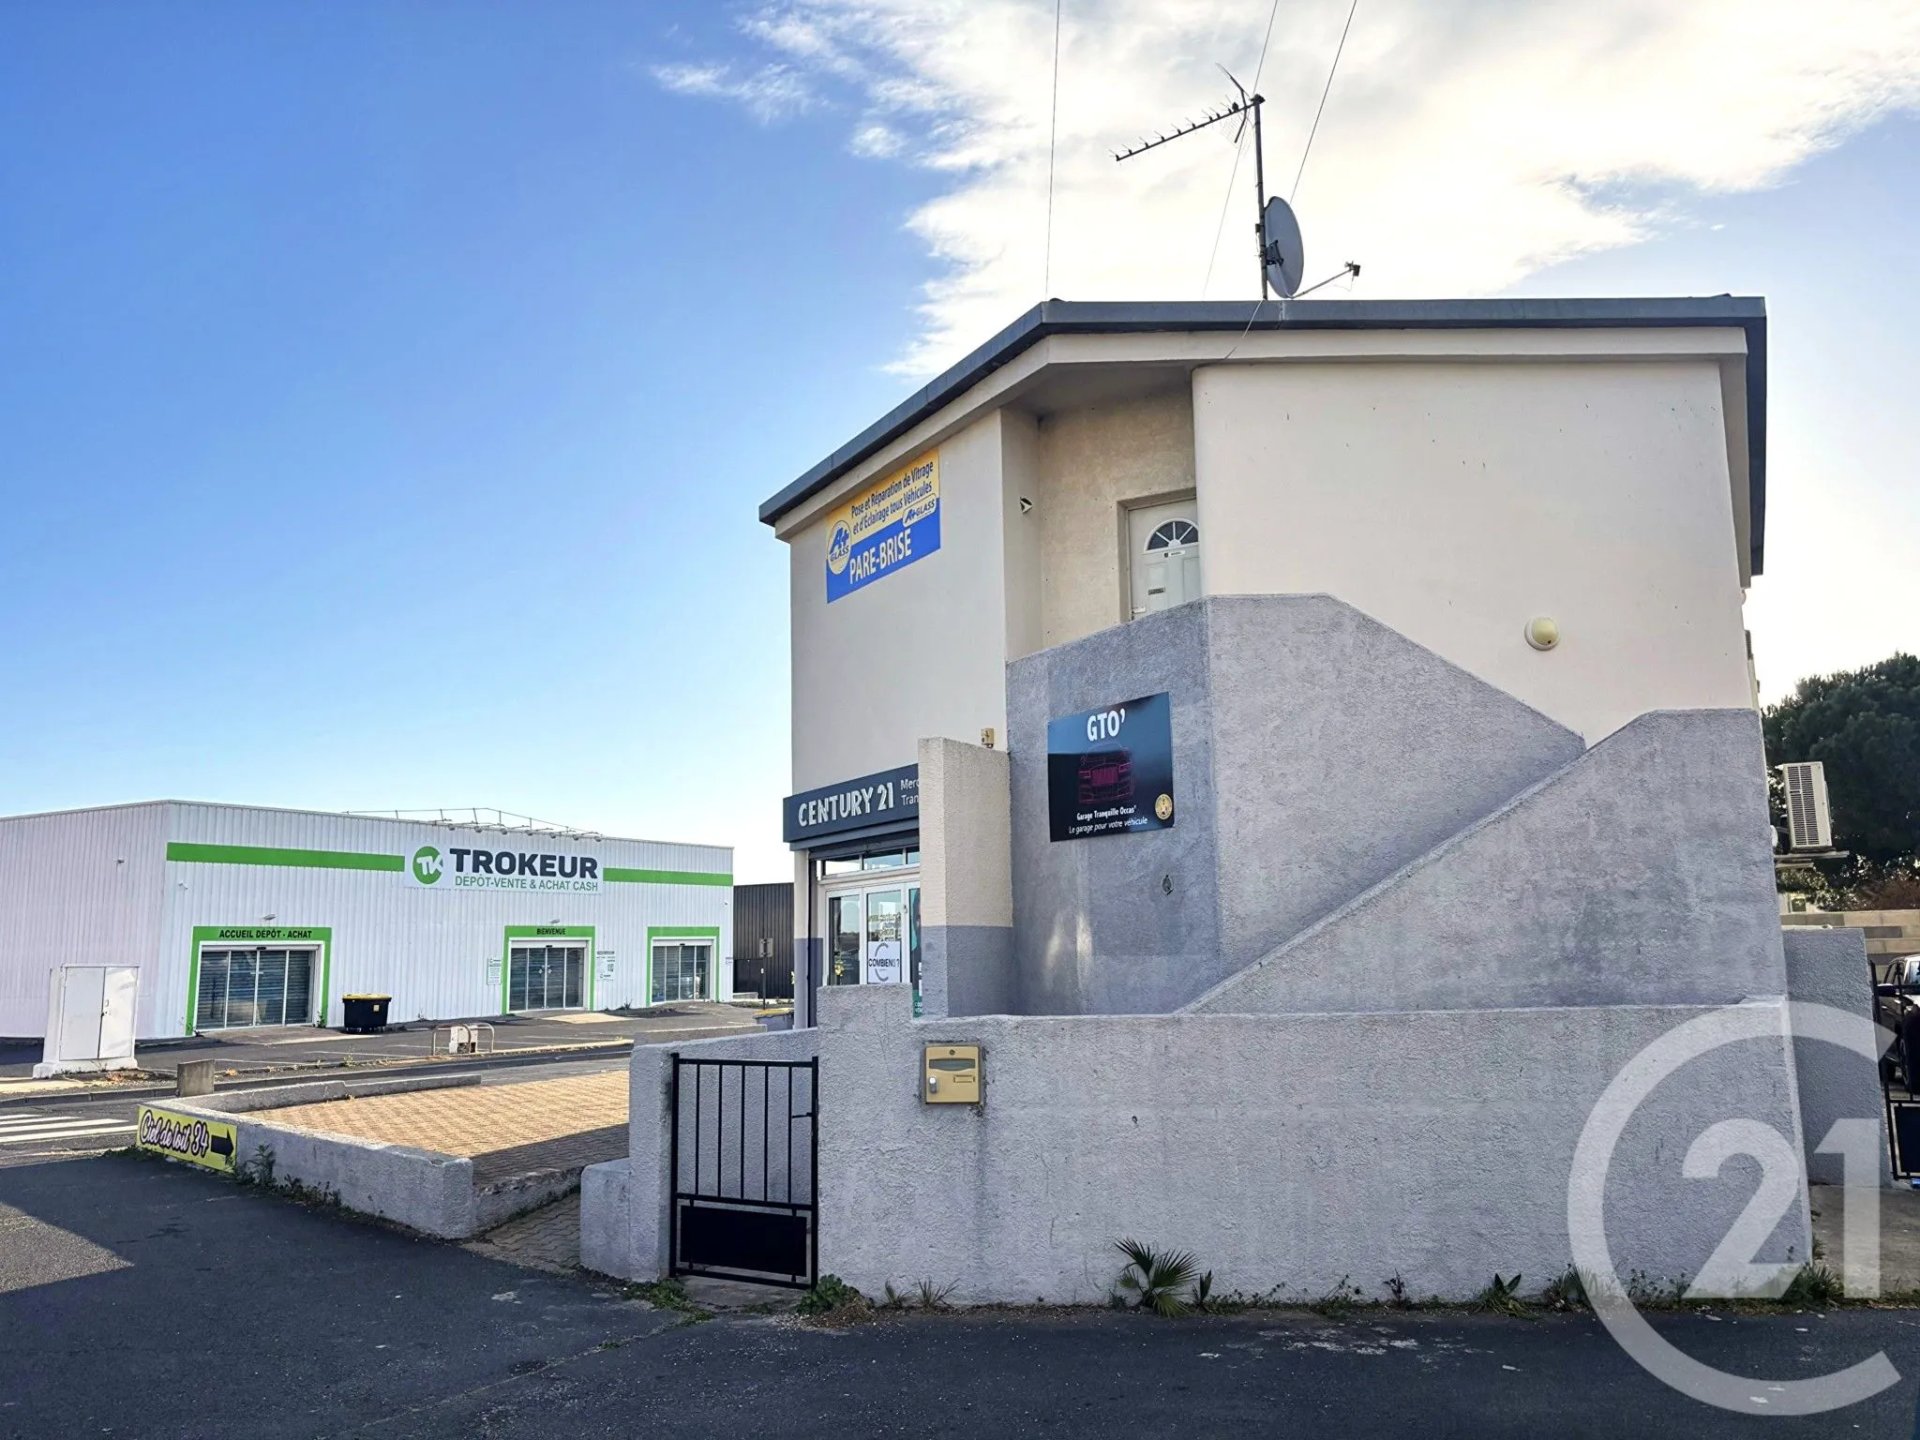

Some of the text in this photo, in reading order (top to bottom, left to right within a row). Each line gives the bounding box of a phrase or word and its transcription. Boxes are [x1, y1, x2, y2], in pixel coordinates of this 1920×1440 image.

[851, 461, 934, 518] Pose et Réparation de Vitrage
[853, 522, 859, 535] et
[890, 498, 903, 514] tous
[903, 481, 933, 506] Véhicules
[830, 545, 850, 562] GLASS
[850, 528, 912, 585] PARE-BRISE
[798, 782, 894, 827] CENTURY 21
[1076, 812, 1093, 822] Garage
[1094, 807, 1119, 819] Tranquille
[1068, 816, 1148, 835] Le garage pour votre véhicule
[450, 848, 598, 879] TROKEUR
[455, 873, 598, 892] DÉPÔT-VENTE & ACHAT CASH
[219, 929, 253, 939] ACCUEIL
[255, 928, 282, 939] DÉPÔT
[287, 930, 312, 939] ACHAT
[140, 1109, 162, 1145] Ciel
[160, 1119, 173, 1150] de
[191, 1120, 209, 1158] 34
